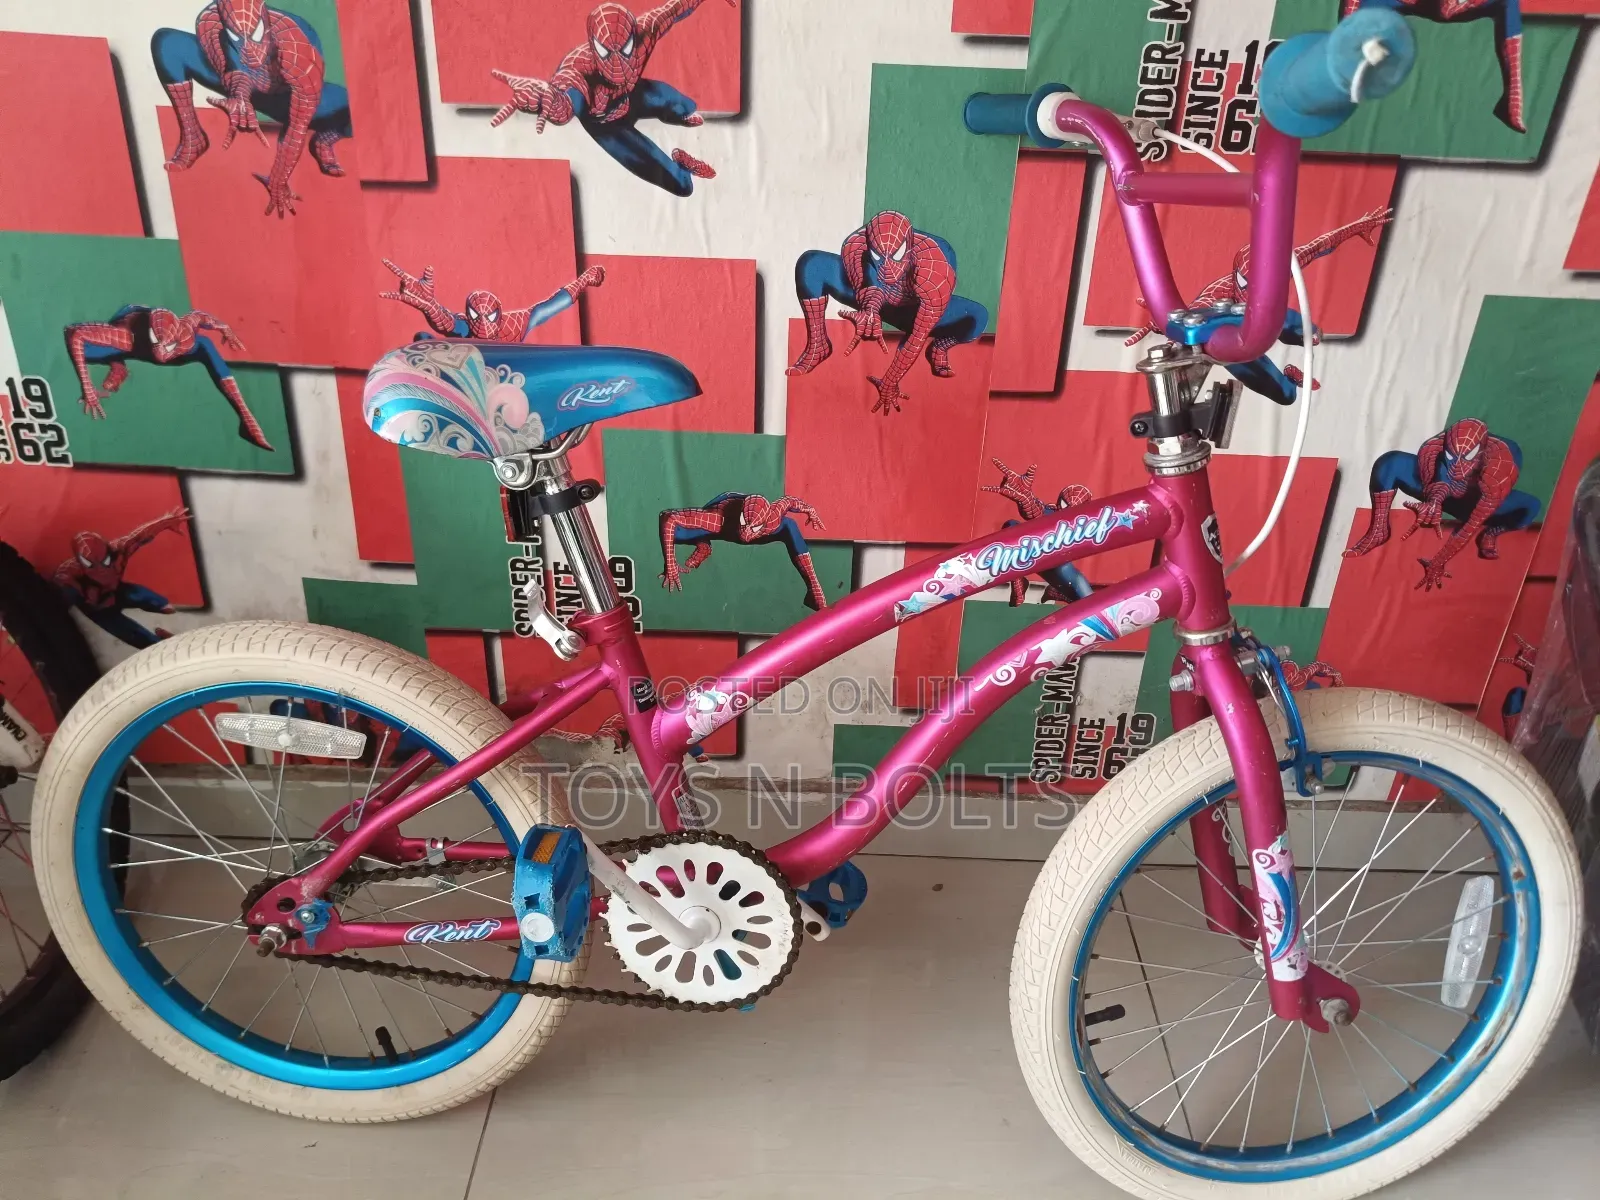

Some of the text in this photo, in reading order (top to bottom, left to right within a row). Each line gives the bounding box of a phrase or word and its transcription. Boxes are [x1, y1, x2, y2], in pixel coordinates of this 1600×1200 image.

[1178, 48, 1229, 153] SINCE
[1218, 97, 1260, 154] 6
[4, 375, 57, 421] 19
[559, 378, 634, 409] Kent
[9, 421, 74, 467] 62
[976, 506, 1118, 577] Mischief
[1070, 717, 1106, 780] SINCE
[1111, 712, 1157, 747] 19
[404, 918, 501, 943] Kent
